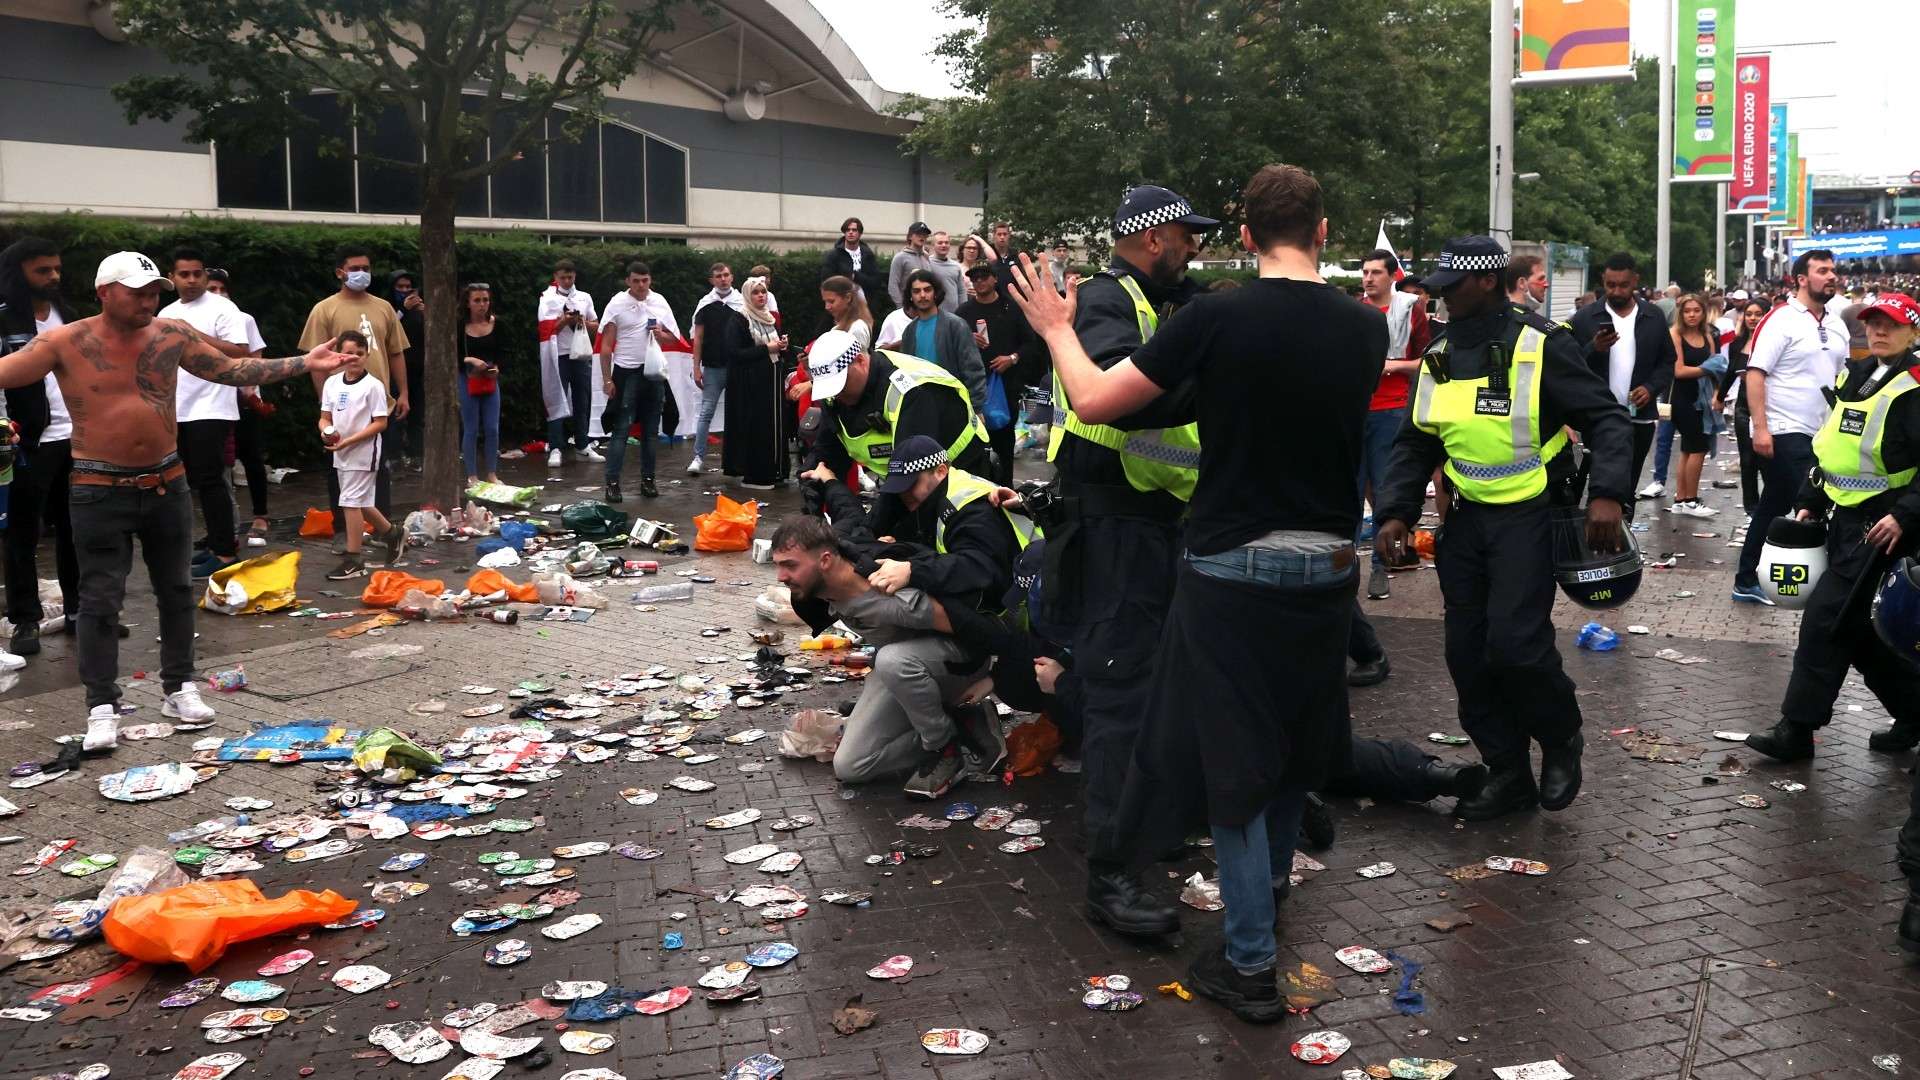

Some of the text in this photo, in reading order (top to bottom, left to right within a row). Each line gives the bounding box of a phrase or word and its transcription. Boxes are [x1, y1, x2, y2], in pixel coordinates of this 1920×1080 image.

[1743, 92, 1755, 188] UEFA EURO 2020
[137, 257, 154, 271] LA
[1578, 568, 1610, 581] POLICE
[1590, 589, 1612, 601] MP
[1778, 584, 1798, 595] MP
